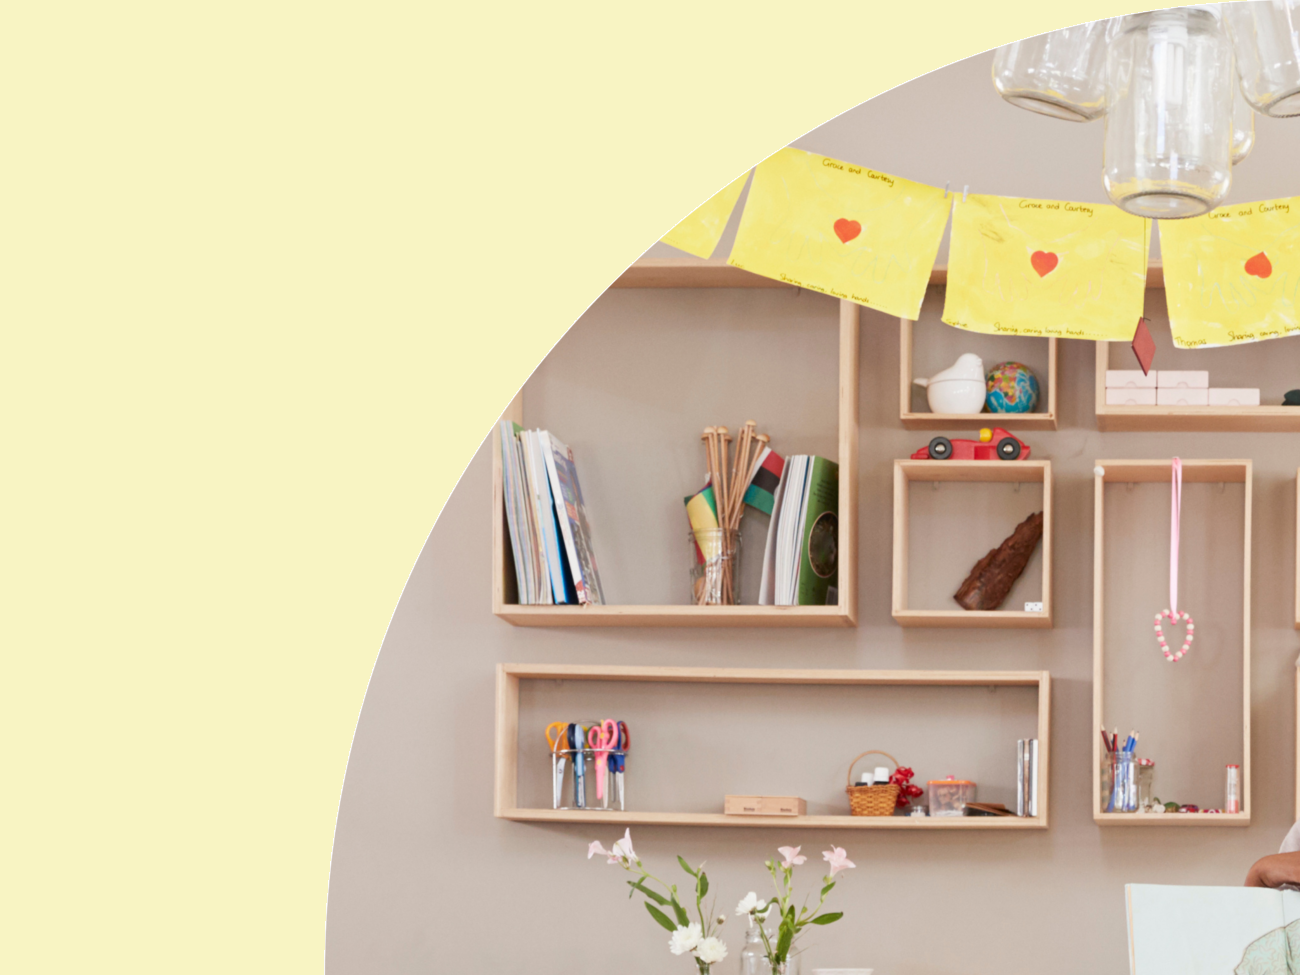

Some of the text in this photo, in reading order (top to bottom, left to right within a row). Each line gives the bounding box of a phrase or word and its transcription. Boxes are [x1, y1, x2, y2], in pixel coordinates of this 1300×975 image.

[822, 158, 895, 188] Grace and Courtesy
[1018, 199, 1094, 218] Grace and Courtesy
[1238, 208, 1253, 217] and
[1259, 203, 1290, 214] Courtesy
[1175, 336, 1207, 349] Thomas
